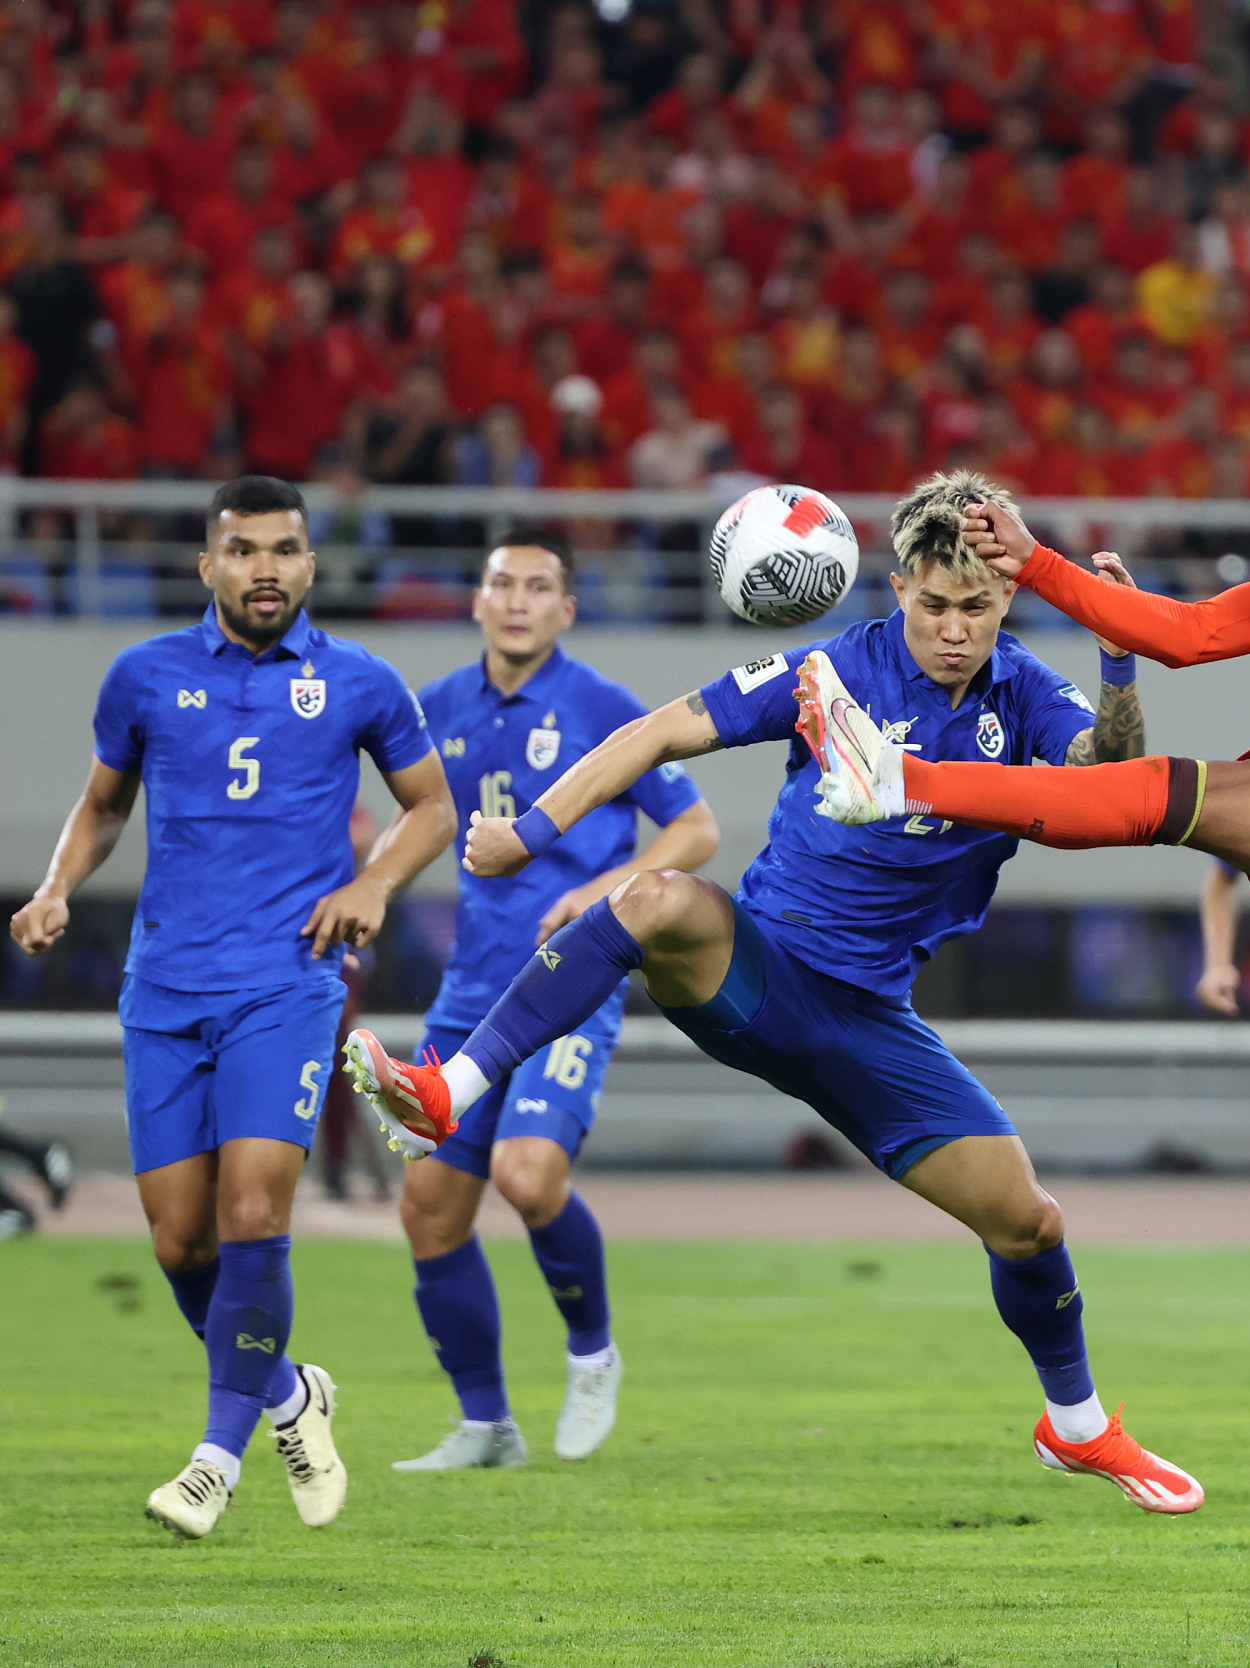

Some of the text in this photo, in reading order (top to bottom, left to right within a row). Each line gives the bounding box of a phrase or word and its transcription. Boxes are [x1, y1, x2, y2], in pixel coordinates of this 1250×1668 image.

[227, 736, 261, 800] 5
[479, 769, 517, 818] 16
[294, 1060, 322, 1119] 5
[543, 1033, 594, 1091] 16
